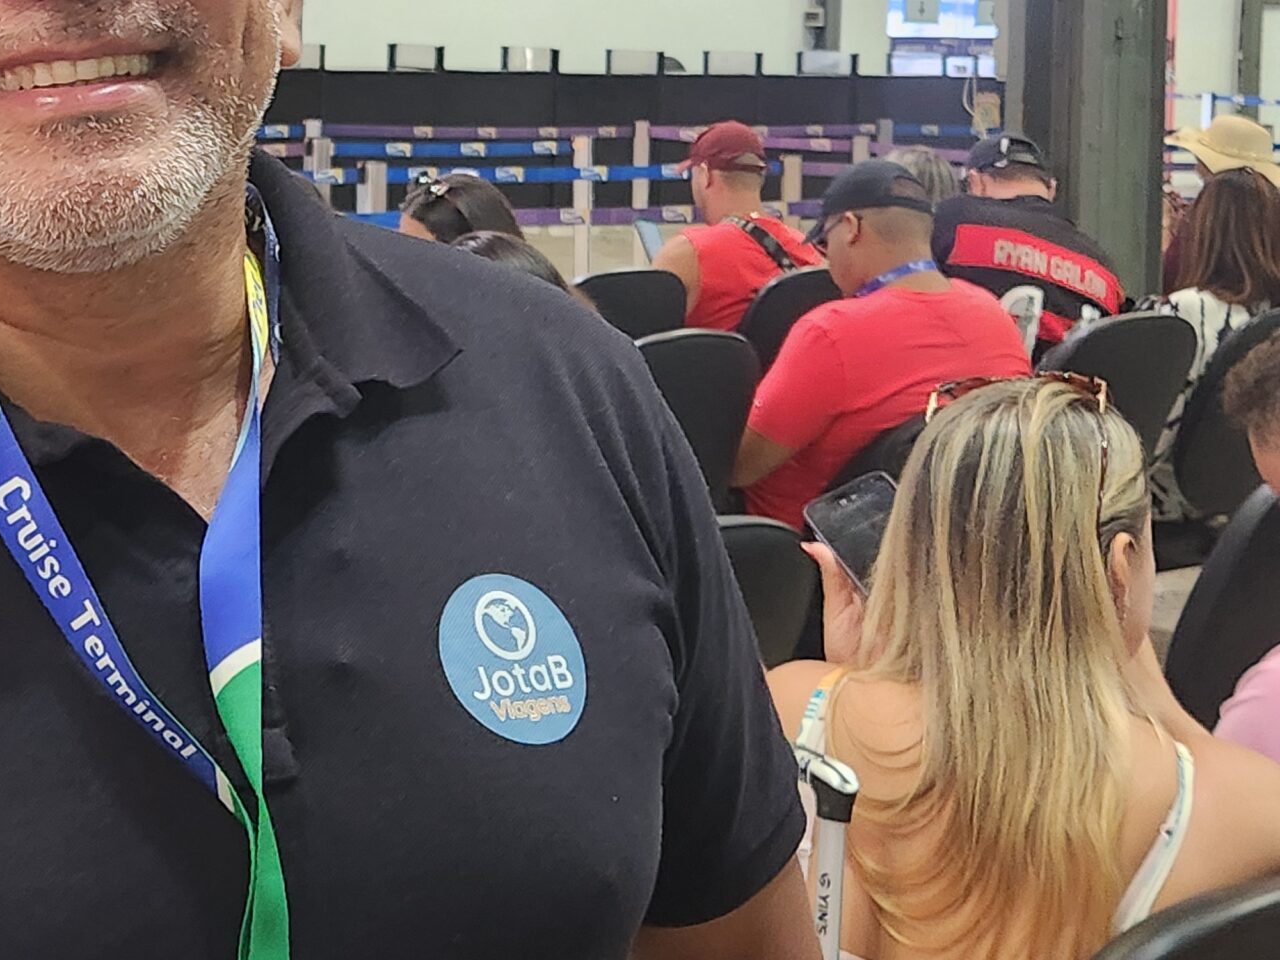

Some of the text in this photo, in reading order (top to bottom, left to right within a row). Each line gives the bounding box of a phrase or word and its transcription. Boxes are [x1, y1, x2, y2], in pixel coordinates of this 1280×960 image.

[993, 238, 1048, 276] RYAN
[69, 598, 198, 760] Terminal
[473, 655, 574, 701] JotaB
[490, 696, 571, 721] Viagens
